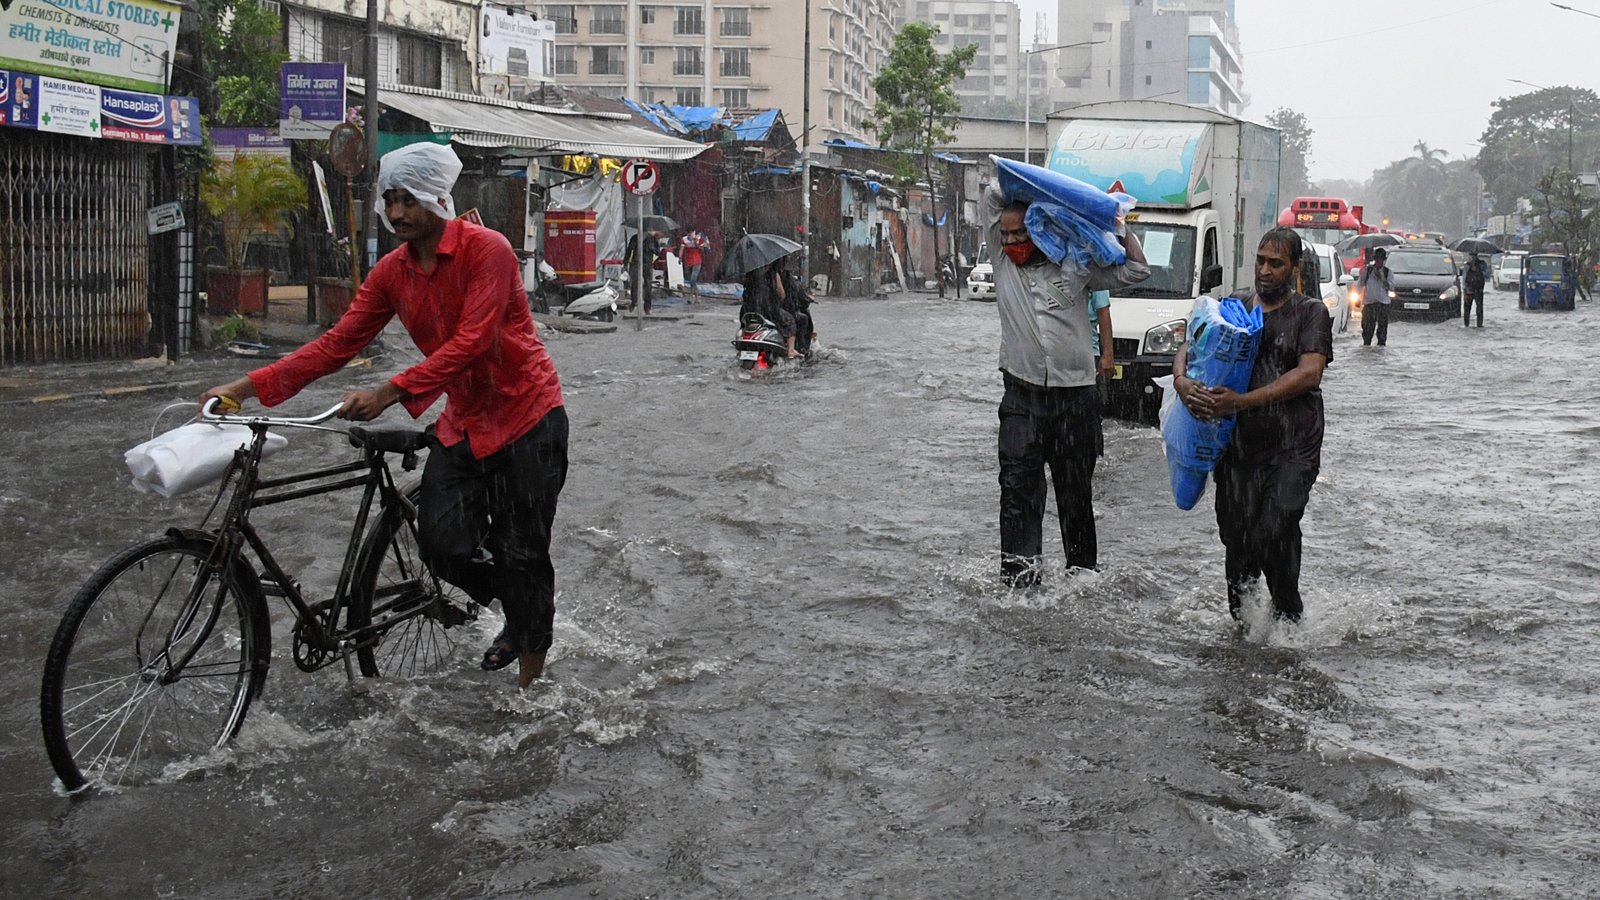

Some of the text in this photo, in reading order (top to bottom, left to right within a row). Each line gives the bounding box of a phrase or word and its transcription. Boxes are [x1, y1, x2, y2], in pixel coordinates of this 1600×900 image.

[19, 5, 119, 35] CHEMISTS & DRUGGISTS
[107, 1, 160, 27] STORES
[9, 22, 41, 43] हमीर
[43, 81, 66, 91] HAMIR
[67, 84, 97, 96] MEDICAL
[104, 95, 160, 113] Hansaplast
